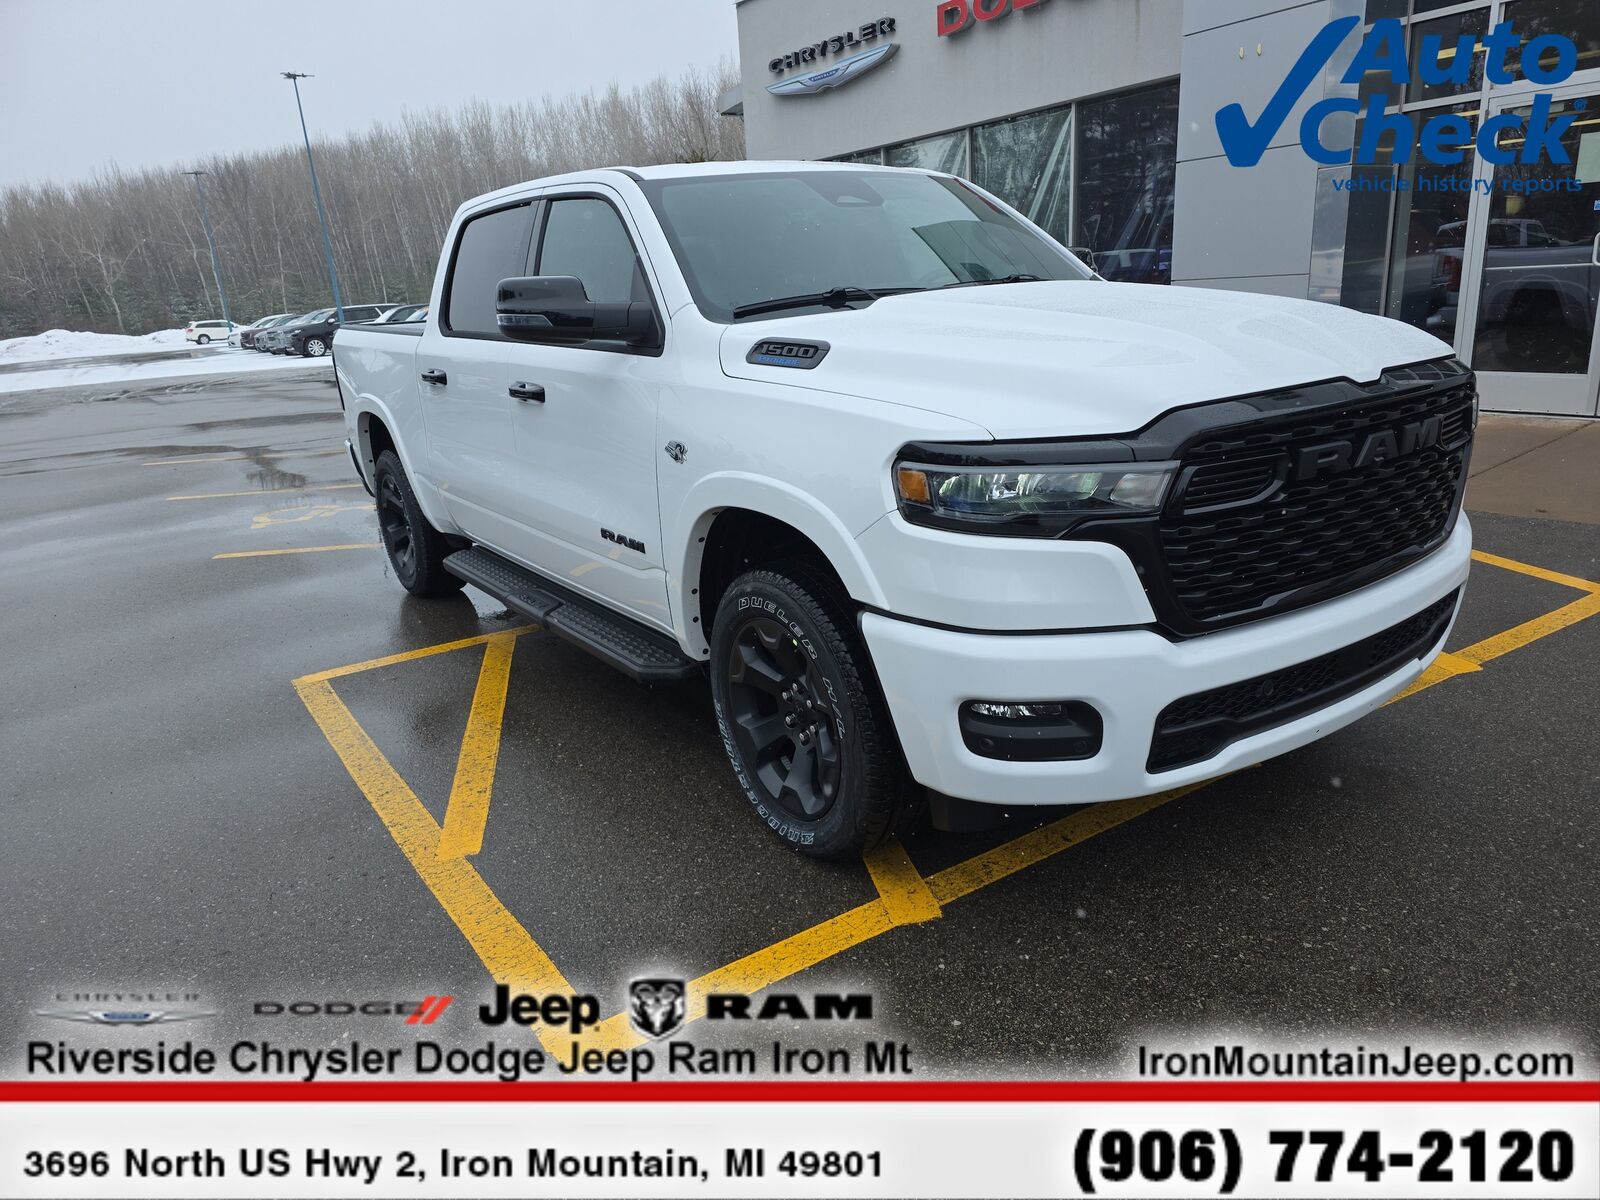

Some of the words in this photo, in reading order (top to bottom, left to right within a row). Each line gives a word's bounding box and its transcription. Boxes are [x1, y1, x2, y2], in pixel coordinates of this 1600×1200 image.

[768, 16, 896, 74] CHRYSLER
[761, 344, 816, 359] 1500
[1298, 415, 1441, 479] RAM
[601, 527, 646, 554] RAM
[738, 596, 817, 661] DUELER
[714, 699, 815, 845] BRIDGESTONE
